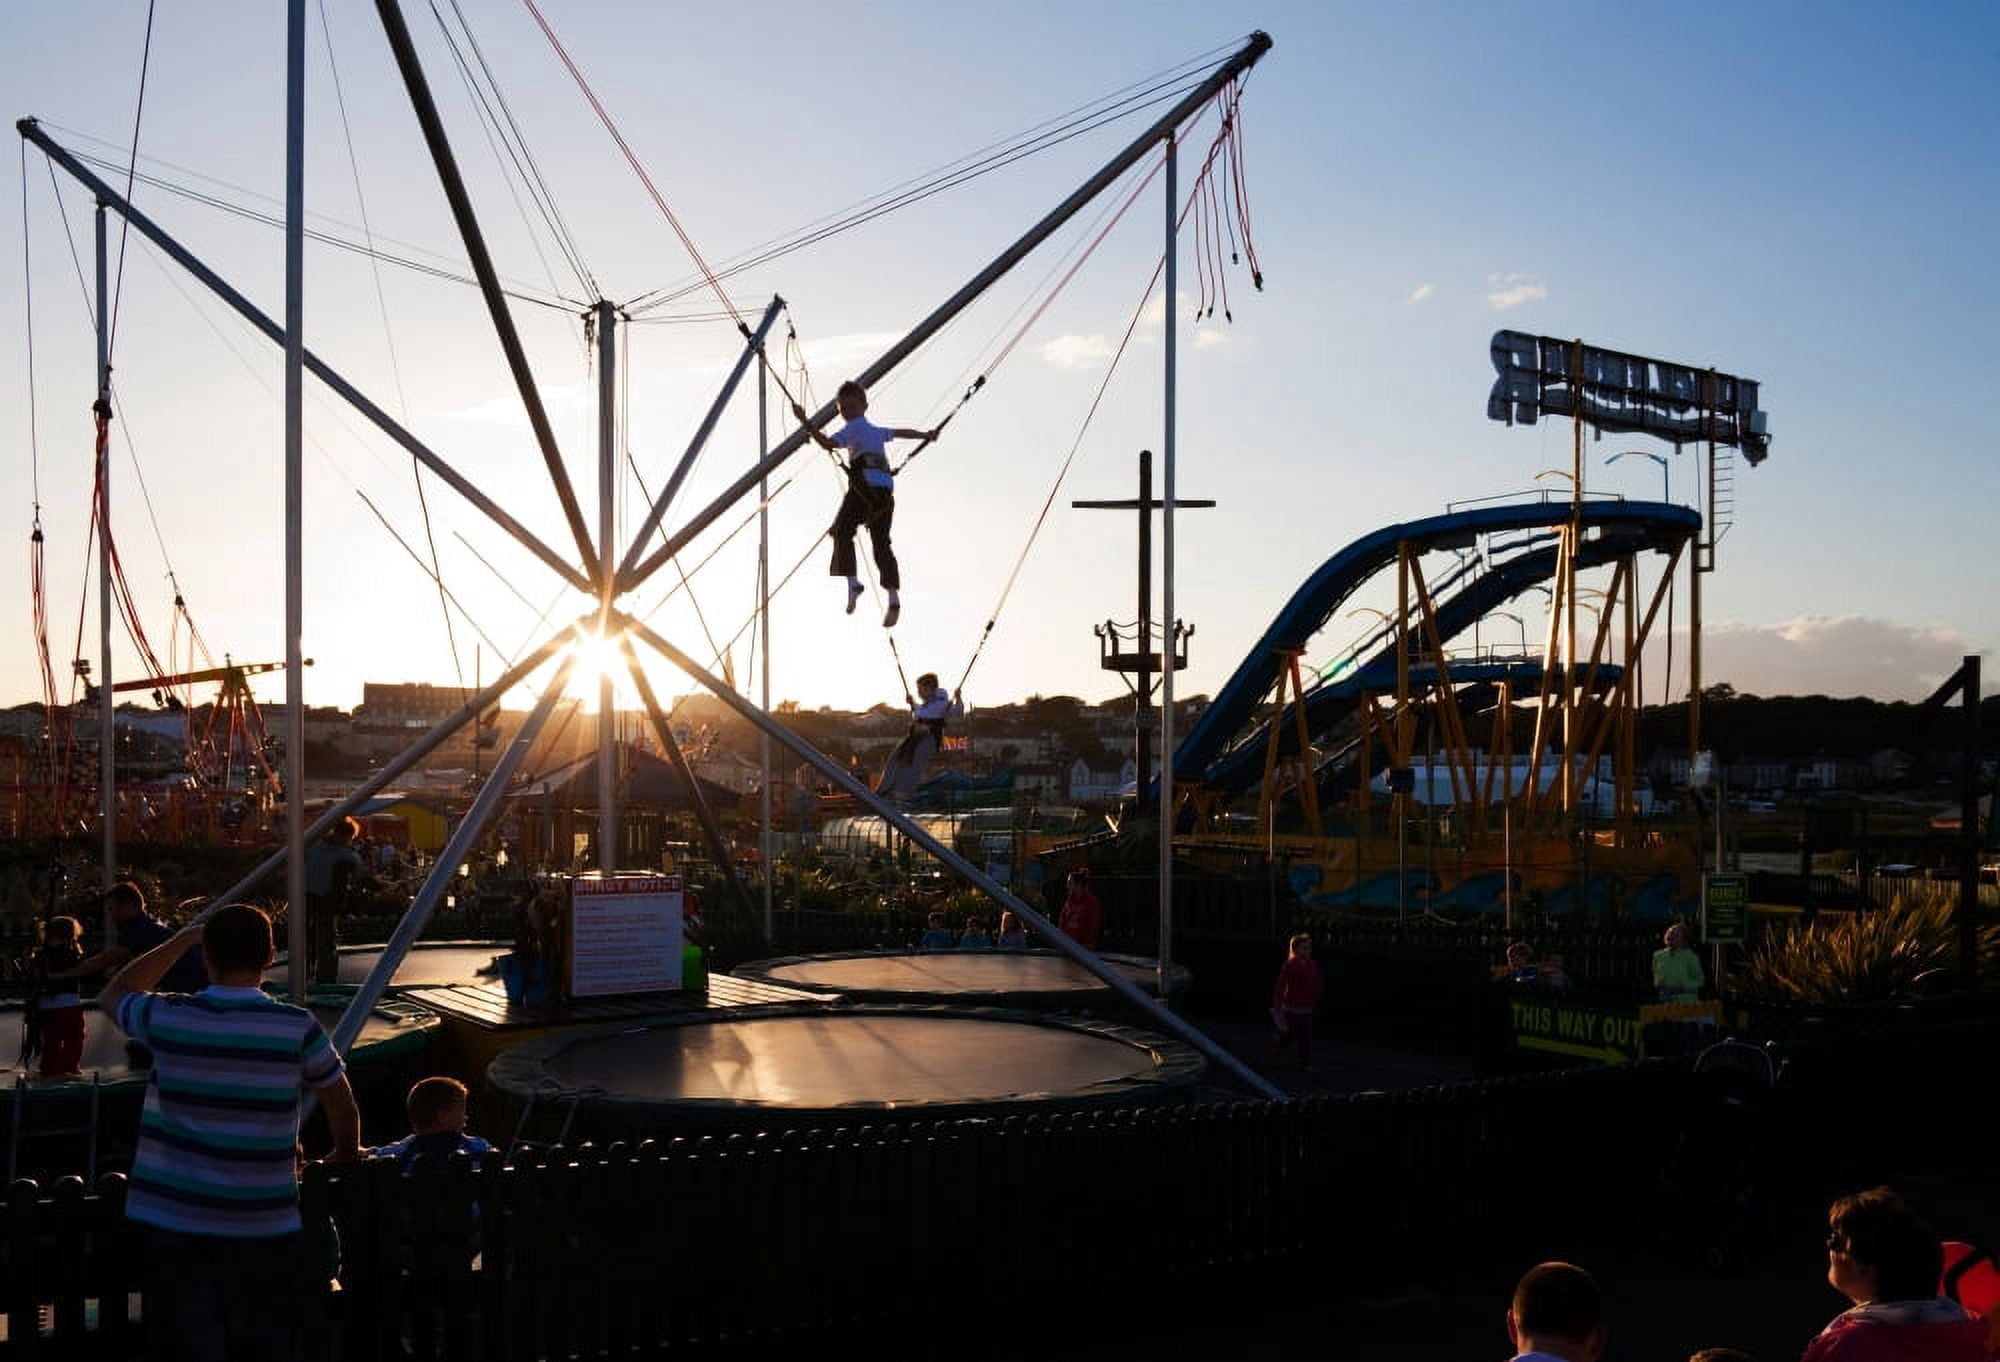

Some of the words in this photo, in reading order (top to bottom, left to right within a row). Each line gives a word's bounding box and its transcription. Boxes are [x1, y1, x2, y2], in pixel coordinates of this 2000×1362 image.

[1510, 1002, 1551, 1034] THIS
[1557, 1008, 1597, 1041] WAY
[1602, 1016, 1644, 1048] OUT
